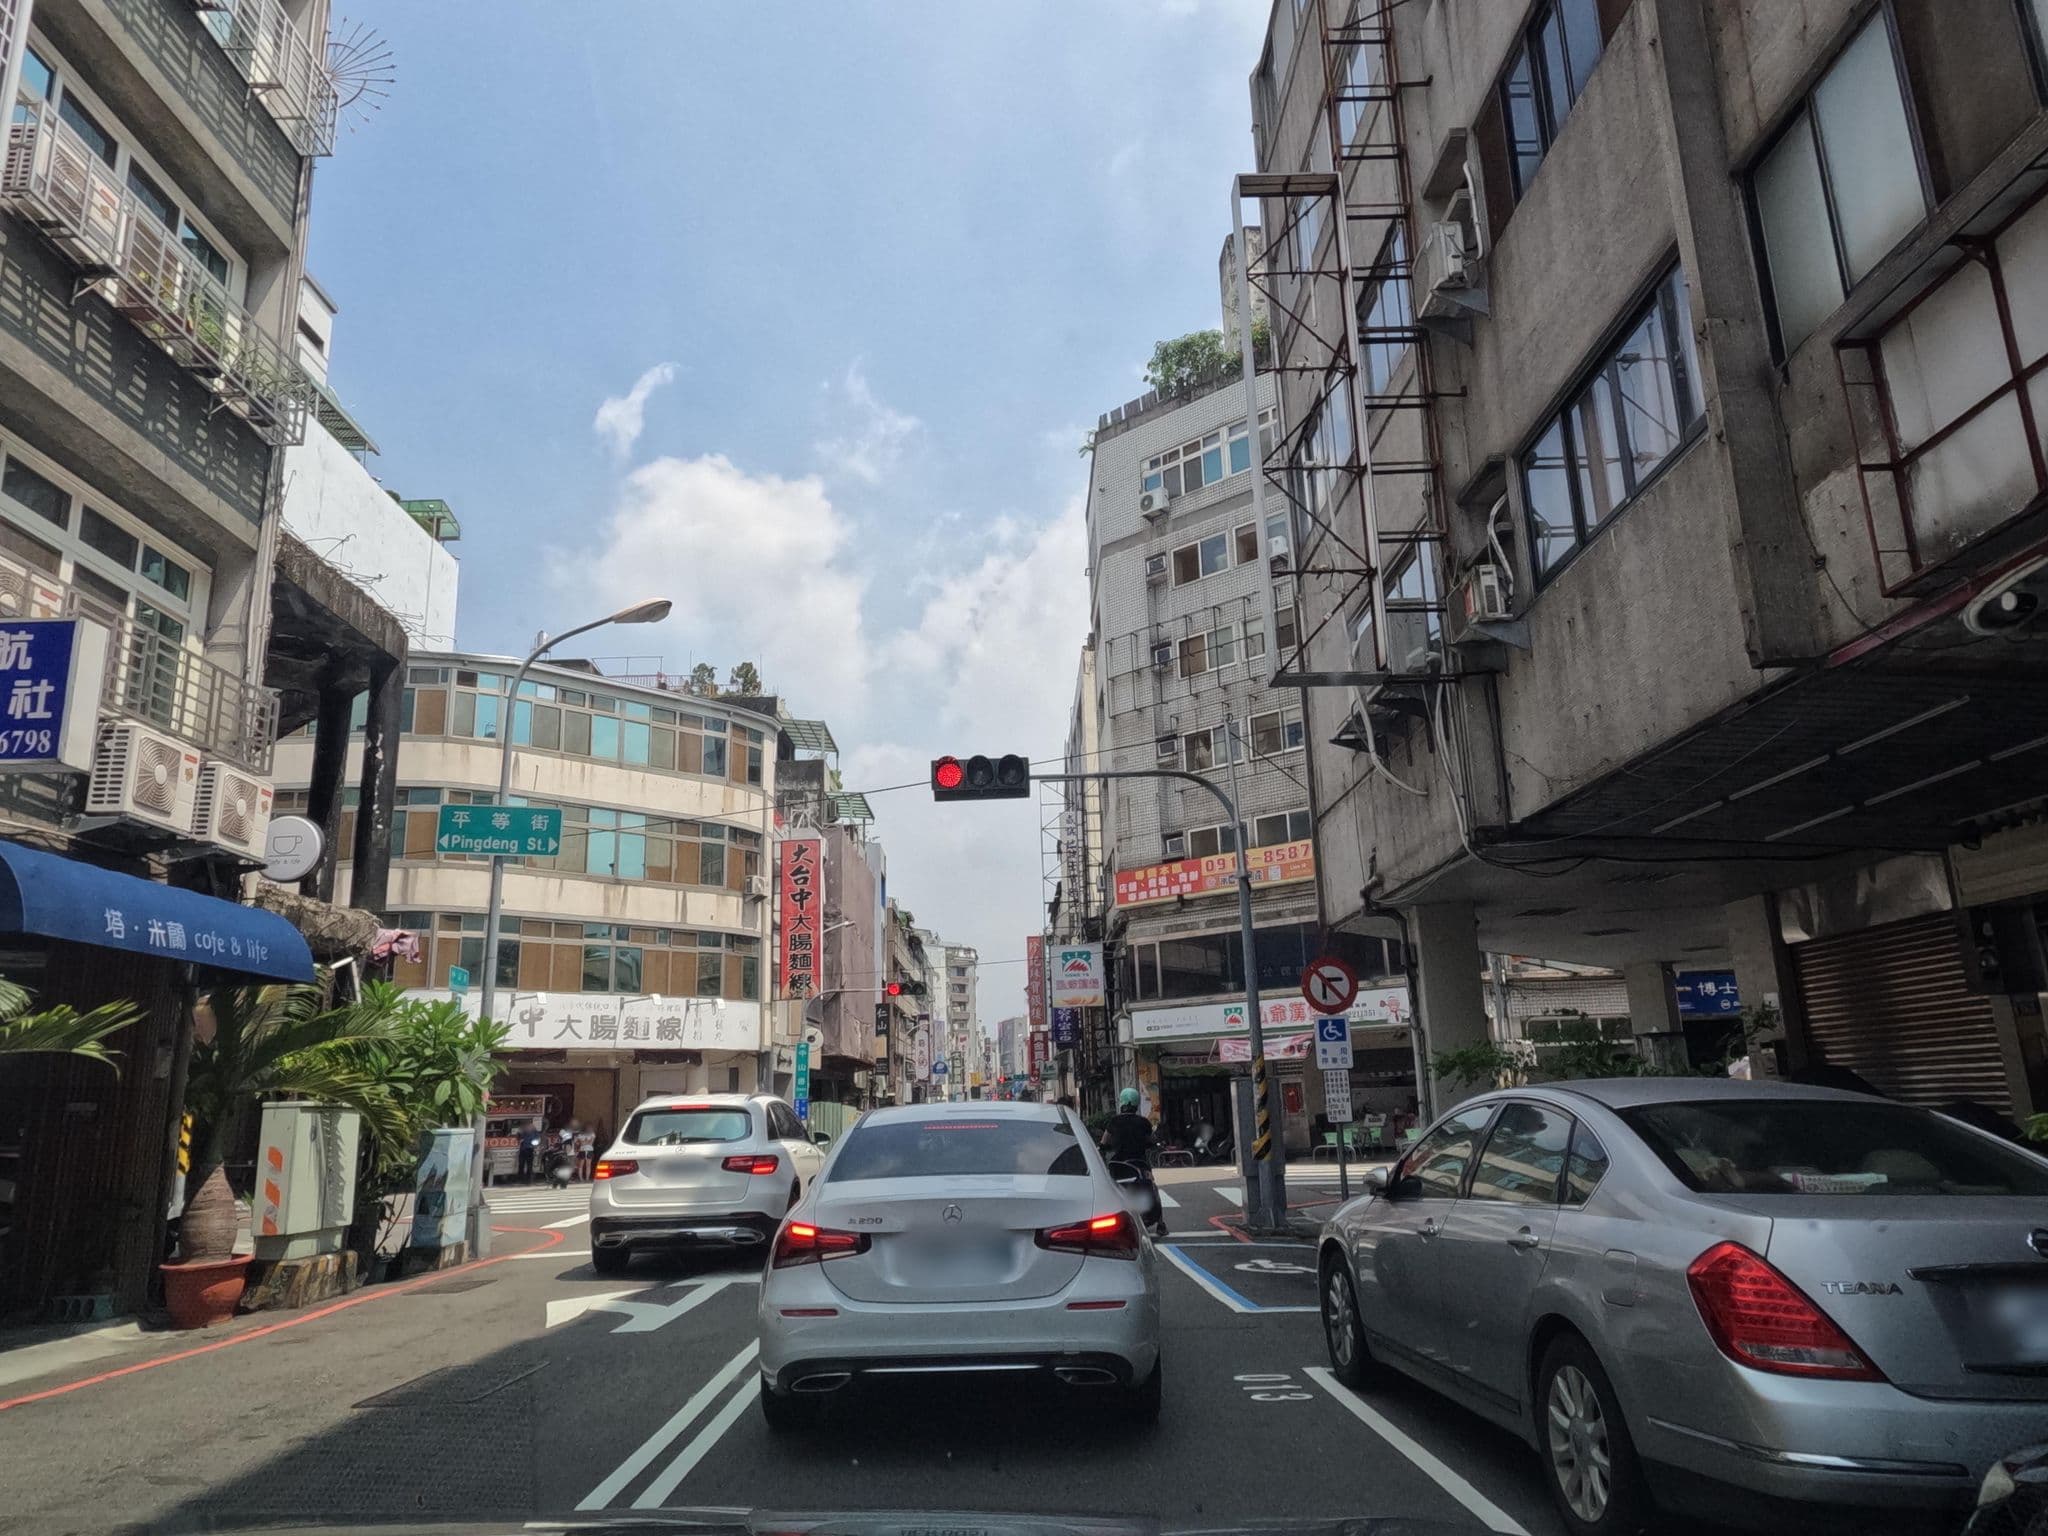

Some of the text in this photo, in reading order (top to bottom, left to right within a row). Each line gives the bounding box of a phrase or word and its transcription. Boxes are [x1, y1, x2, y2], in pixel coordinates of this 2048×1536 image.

[8, 679, 55, 719] 社
[451, 811, 549, 831] 平等街
[451, 834, 546, 852] Pingdeng St.
[789, 843, 814, 991] 大台中大腸麵線
[230, 937, 242, 956] &
[246, 938, 269, 964] life
[1821, 1281, 1904, 1296] TEANA
